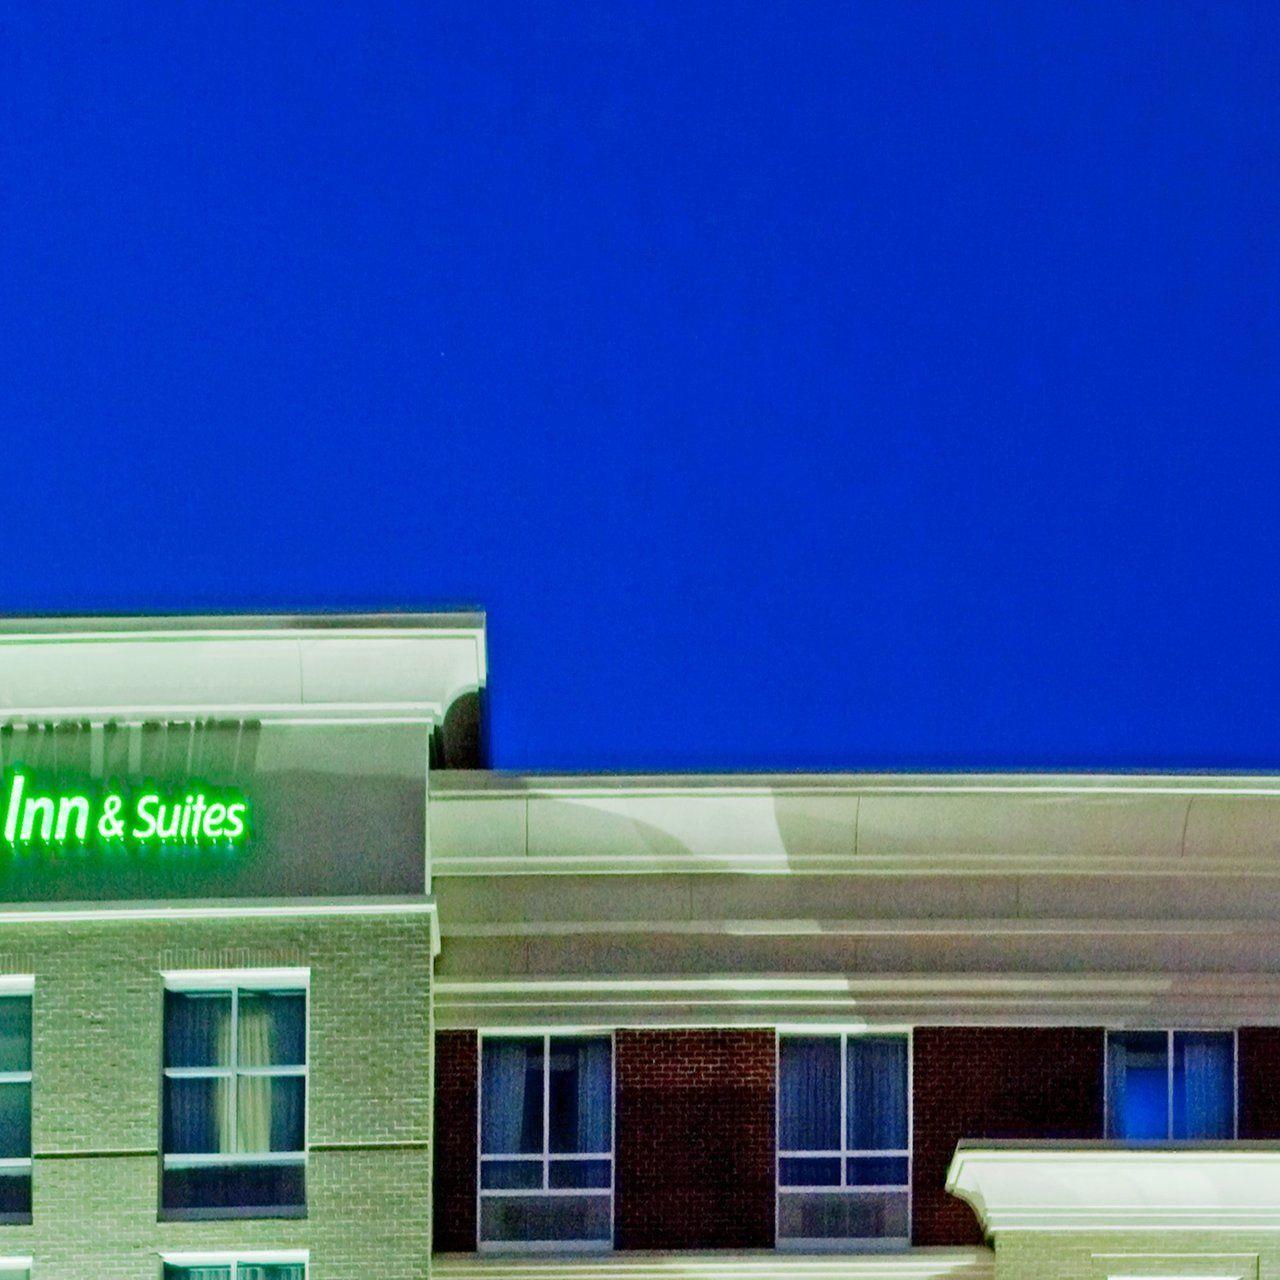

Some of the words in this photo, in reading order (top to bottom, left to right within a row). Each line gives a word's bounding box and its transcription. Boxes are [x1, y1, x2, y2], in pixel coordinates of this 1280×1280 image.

[4, 774, 89, 842] Inn
[97, 794, 125, 838] &
[132, 793, 246, 839] Suites
